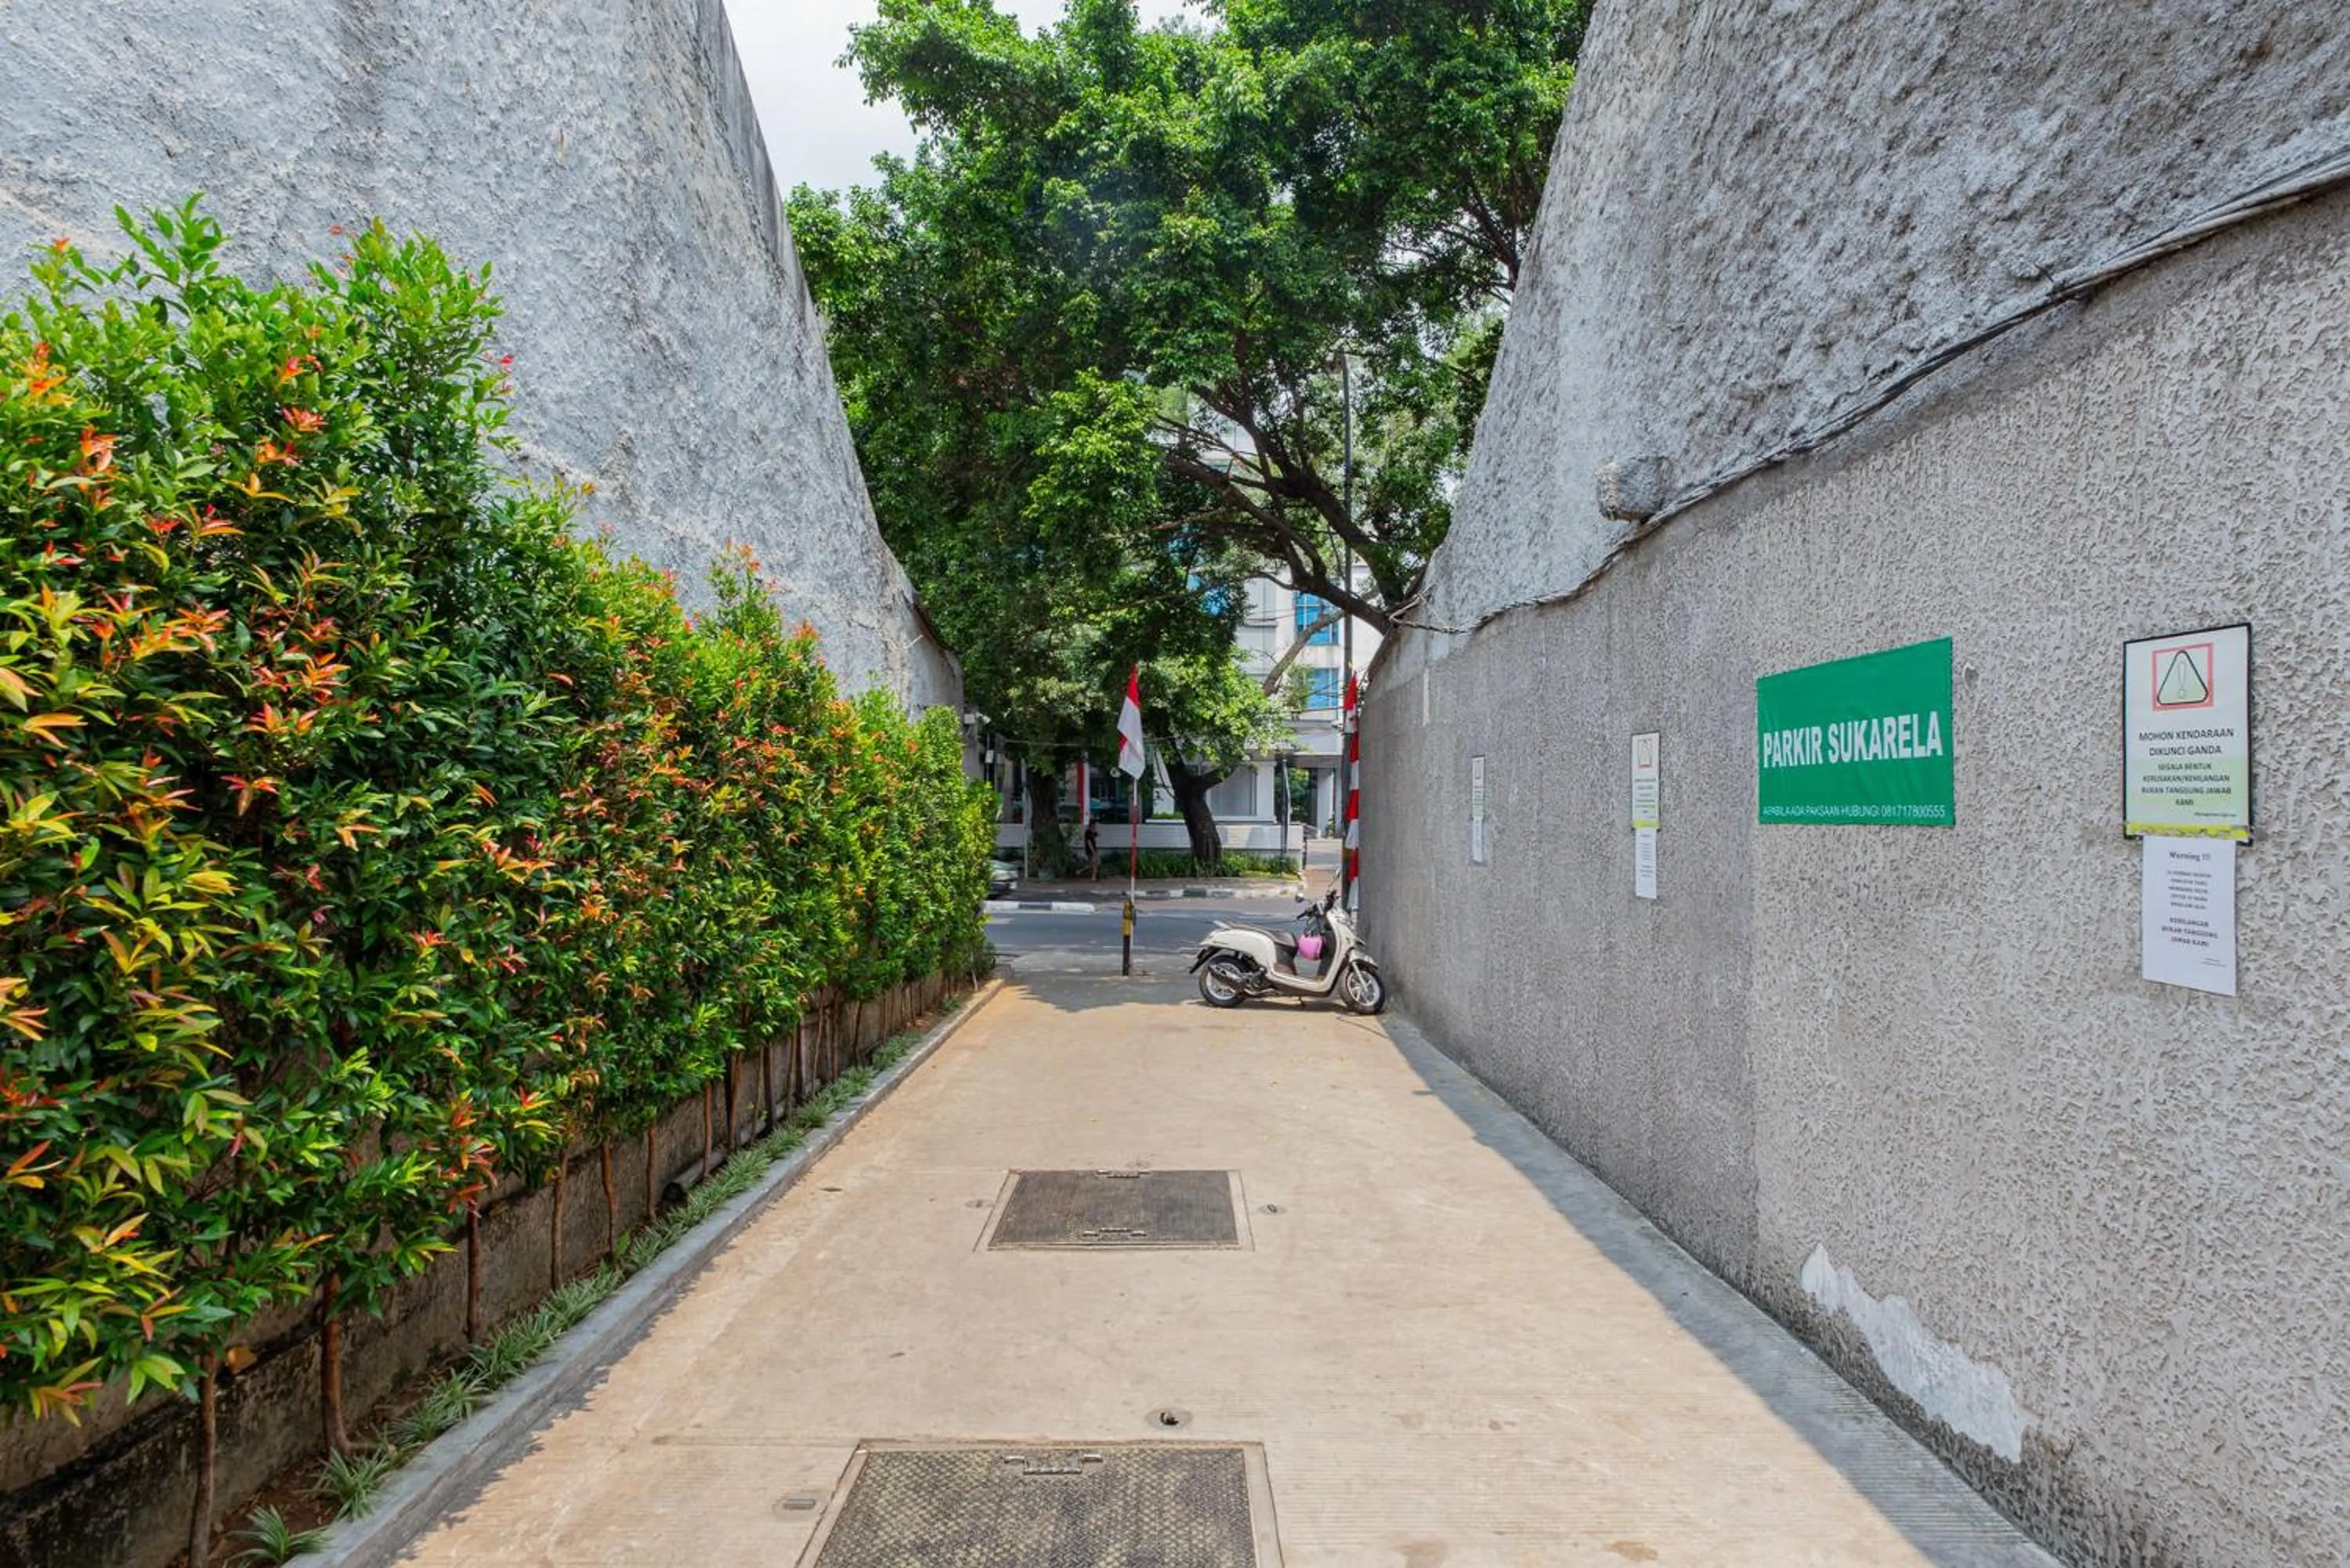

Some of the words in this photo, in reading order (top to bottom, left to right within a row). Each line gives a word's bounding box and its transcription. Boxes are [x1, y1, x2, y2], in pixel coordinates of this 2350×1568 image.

[1763, 726, 1823, 768] PARKIR
[1828, 710, 1943, 764] SUKARELA
[2138, 732, 2174, 741] MOHON
[2175, 728, 2234, 740] KENDARAAN
[2149, 746, 2186, 757] DIKUNCI
[2187, 745, 2222, 756] GANDA
[2169, 851, 2200, 862] Warning
